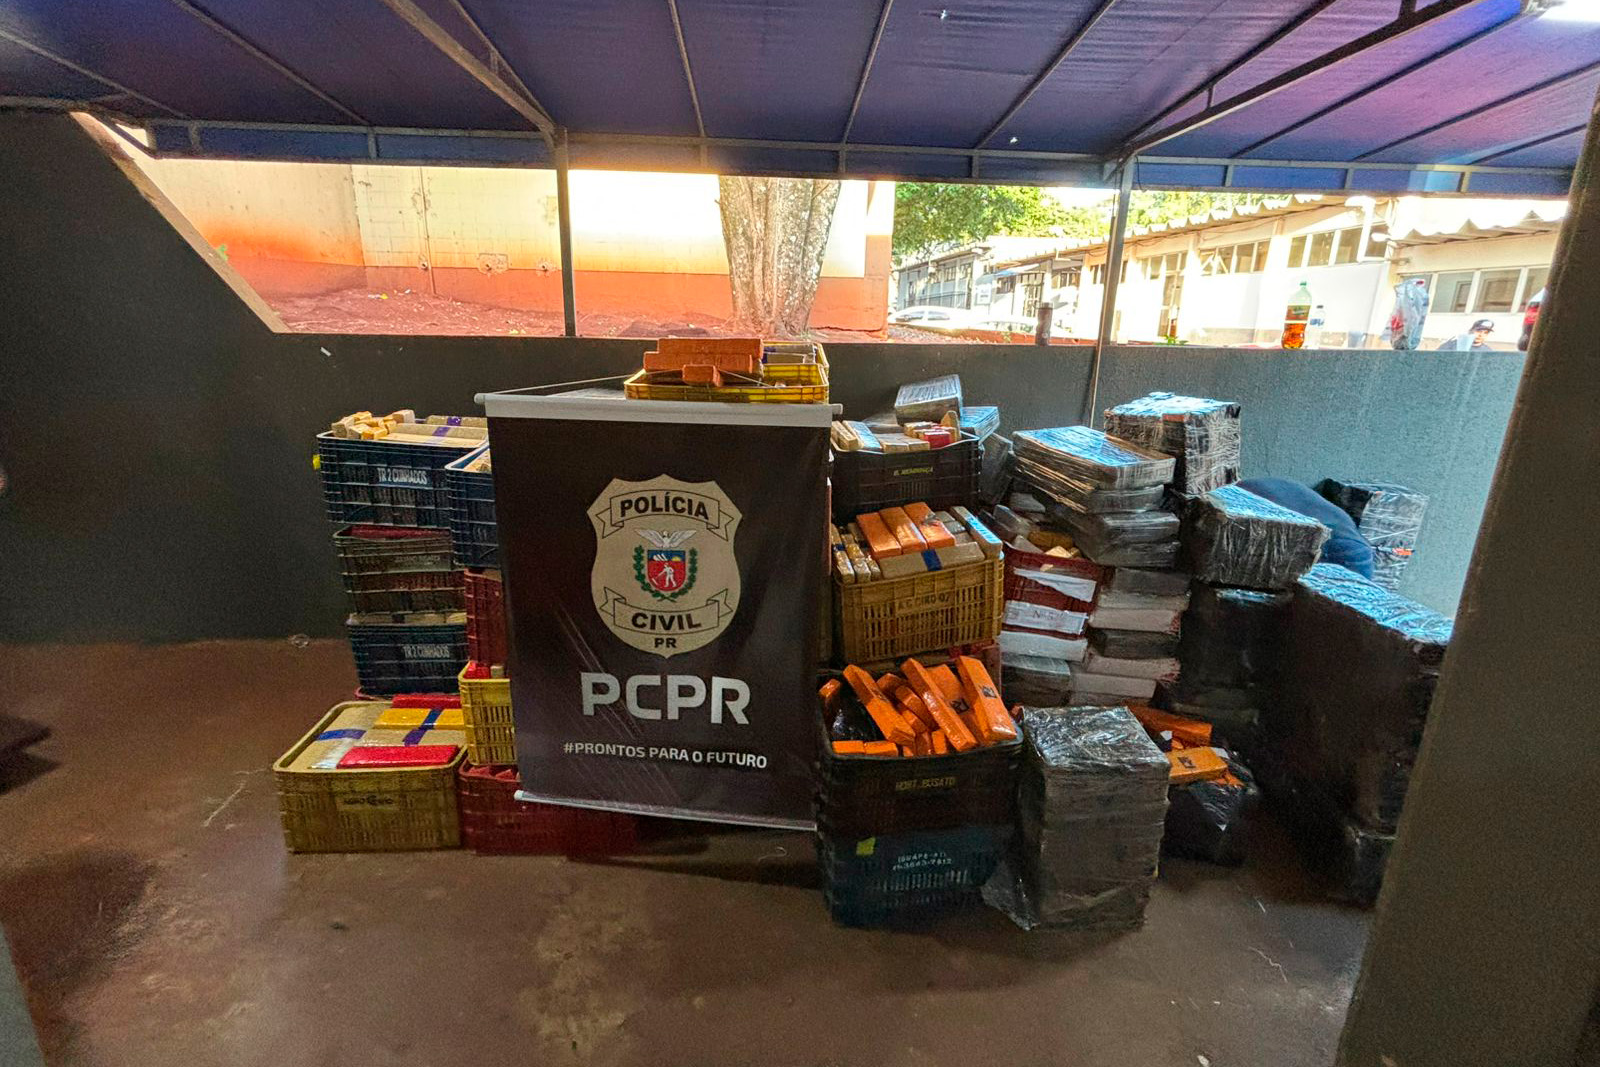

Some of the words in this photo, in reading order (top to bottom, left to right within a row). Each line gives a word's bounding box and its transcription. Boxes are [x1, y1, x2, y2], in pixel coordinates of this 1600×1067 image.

[620, 492, 710, 520] POLÍCIA
[631, 612, 702, 631] CIVIL
[654, 637, 677, 648] PR
[581, 672, 751, 724] PCPR
[563, 742, 646, 758] #PRONTOS
[649, 747, 689, 761] PARA
[692, 751, 703, 763] O
[706, 752, 767, 769] FUTURO
